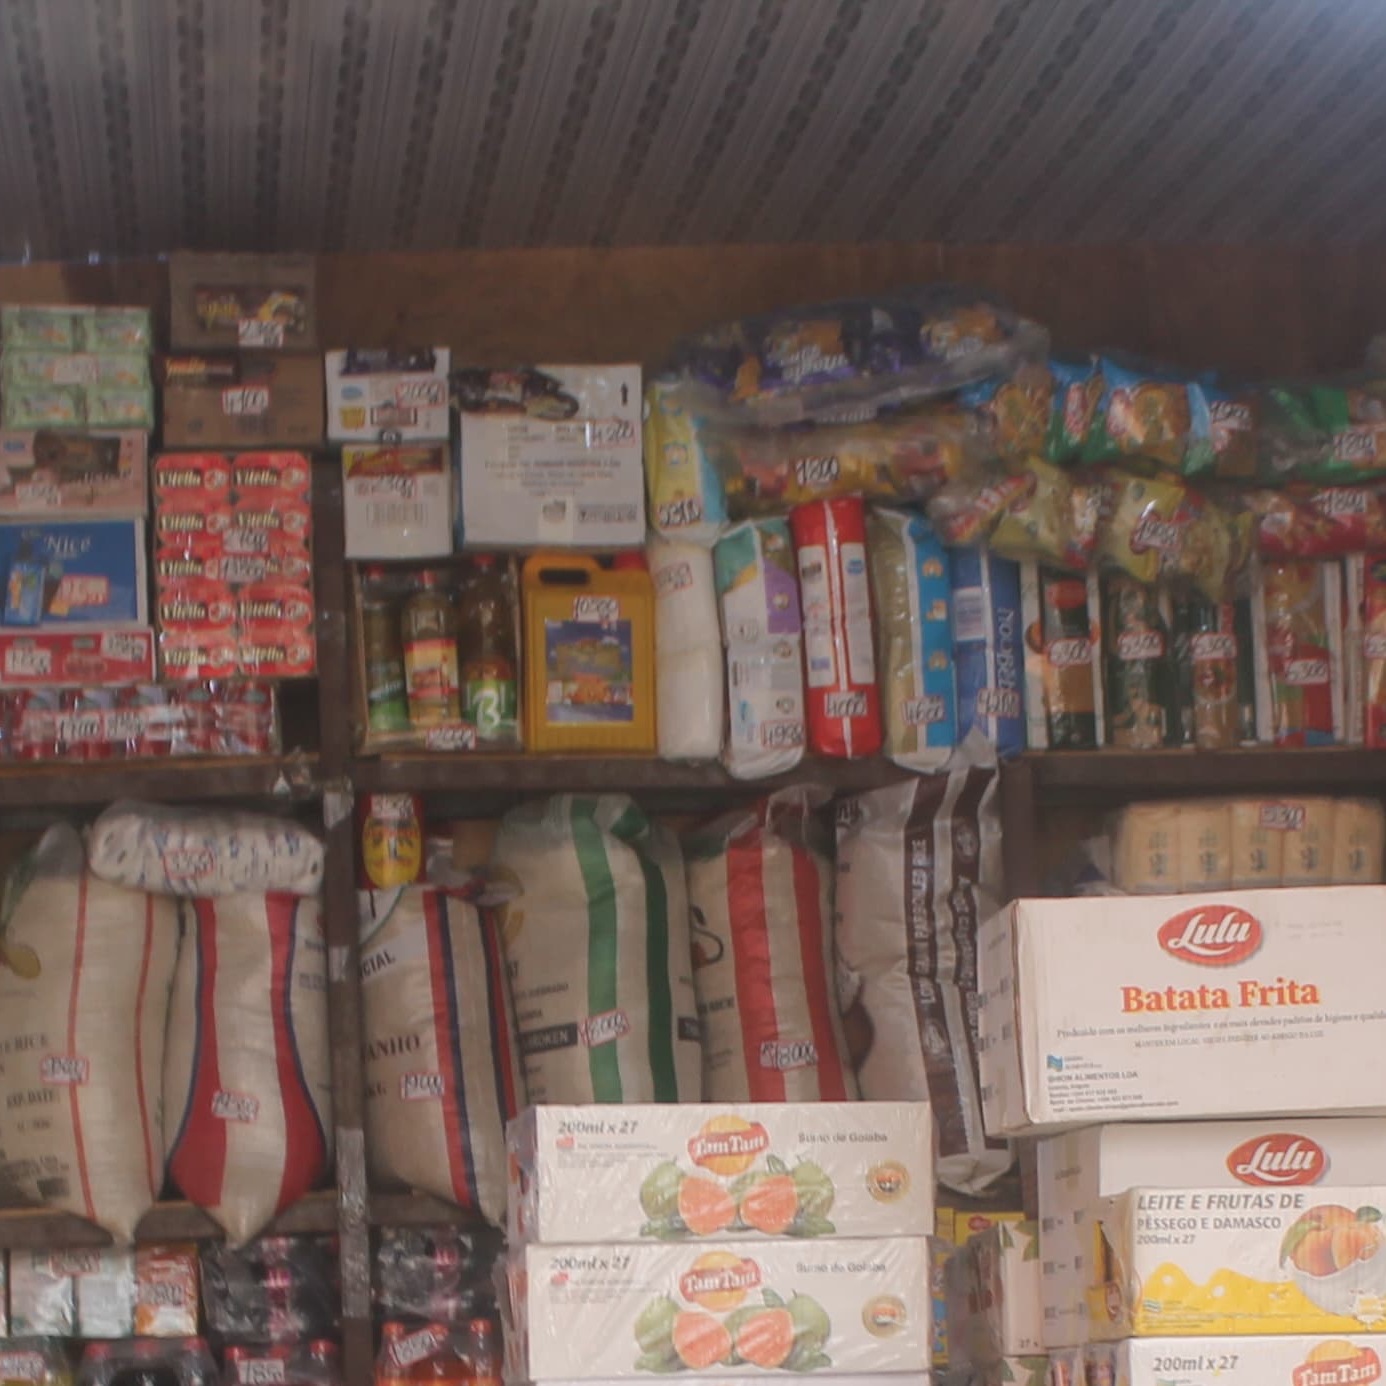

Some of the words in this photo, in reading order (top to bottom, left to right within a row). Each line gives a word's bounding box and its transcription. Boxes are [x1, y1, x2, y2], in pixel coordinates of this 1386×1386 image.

[1168, 910, 1251, 956] Lulu
[1120, 982, 1231, 1013] Batata
[1238, 976, 1320, 1008] Frita
[557, 1121, 605, 1135] 200ml
[607, 1123, 617, 1133] x
[618, 1120, 638, 1133] 27
[1236, 1146, 1316, 1184] Lulu
[1137, 1194, 1185, 1210] LEITE
[1190, 1194, 1203, 1210] E
[1206, 1193, 1275, 1210] FRUTAS
[1278, 1193, 1304, 1209] DE
[1201, 1217, 1211, 1230] E
[1213, 1216, 1281, 1230] DAMASCO
[1136, 1233, 1172, 1245] 200ml
[1172, 1236, 1180, 1244] x
[1181, 1233, 1196, 1245] 27
[549, 1256, 597, 1271] 200ml
[599, 1259, 610, 1270] x
[611, 1255, 631, 1270] 27
[1153, 1356, 1204, 1373] 200ml
[1205, 1358, 1216, 1370] x
[1218, 1355, 1238, 1371] 27
